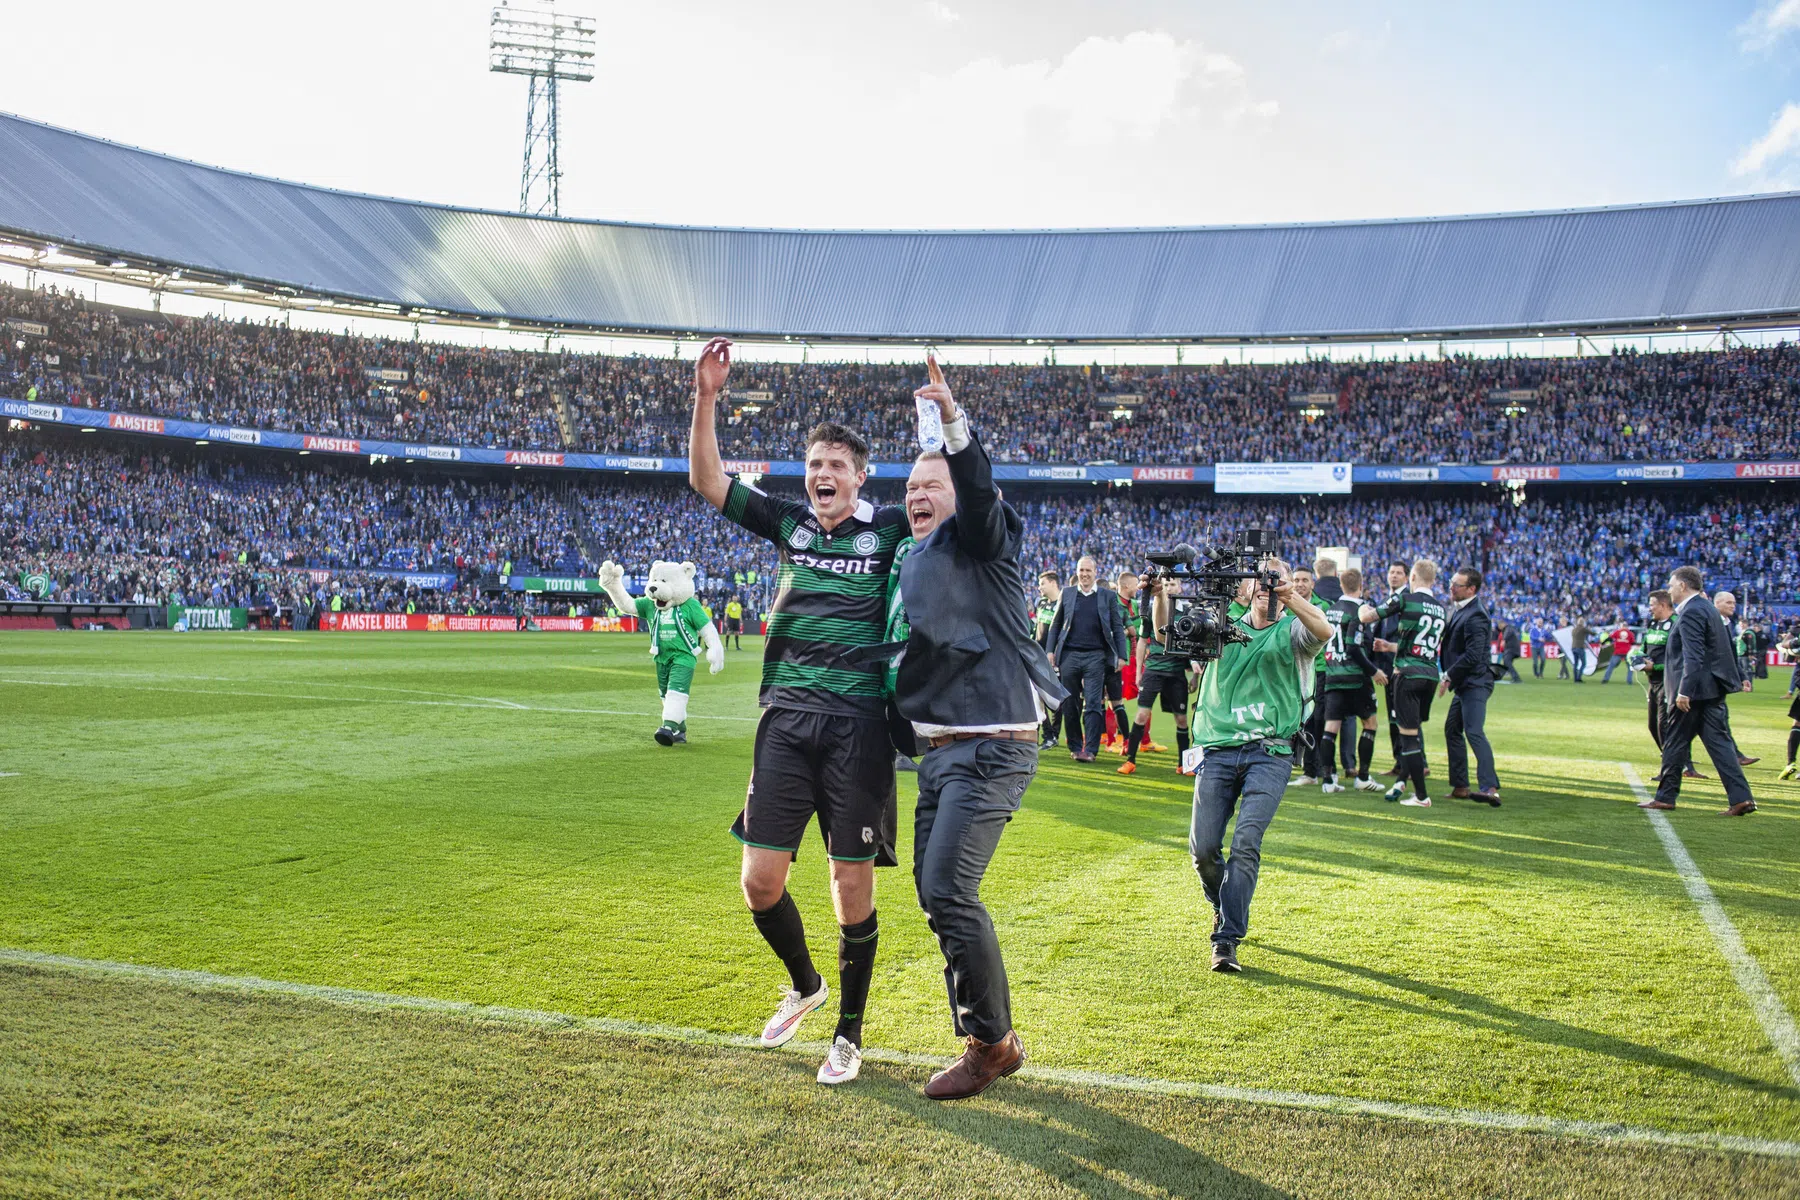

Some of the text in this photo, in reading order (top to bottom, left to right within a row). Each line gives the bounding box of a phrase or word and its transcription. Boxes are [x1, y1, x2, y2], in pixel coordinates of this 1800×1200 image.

[5, 402, 50, 417] KNVB beker
[114, 416, 160, 432] AMSTEL
[209, 427, 251, 441] KNVB beker
[308, 436, 356, 452] AMSTEL
[405, 446, 449, 458] KNVB beker
[510, 452, 560, 465] AMSTEL
[606, 458, 650, 469] KNVB beker
[1028, 467, 1074, 478] KNVB beker
[1138, 469, 1188, 480] AMSTEL
[1376, 470, 1426, 479] KNVB beker
[1498, 467, 1553, 479] AMSTEL
[1616, 468, 1670, 478] KNVB beker
[1742, 465, 1800, 476] AMSTEL
[791, 555, 880, 574] essent
[405, 575, 440, 588] ESPECT
[545, 579, 588, 591] TOTO NL
[184, 608, 233, 628] TOTO.NL
[341, 614, 408, 629] AMSTEL BIER
[449, 617, 480, 630] FELICITEERT
[482, 617, 488, 630] FC
[542, 619, 584, 630] OVERWINNING
[1326, 623, 1344, 652] 21
[1413, 615, 1445, 649] 23
[1231, 702, 1265, 725] TV
